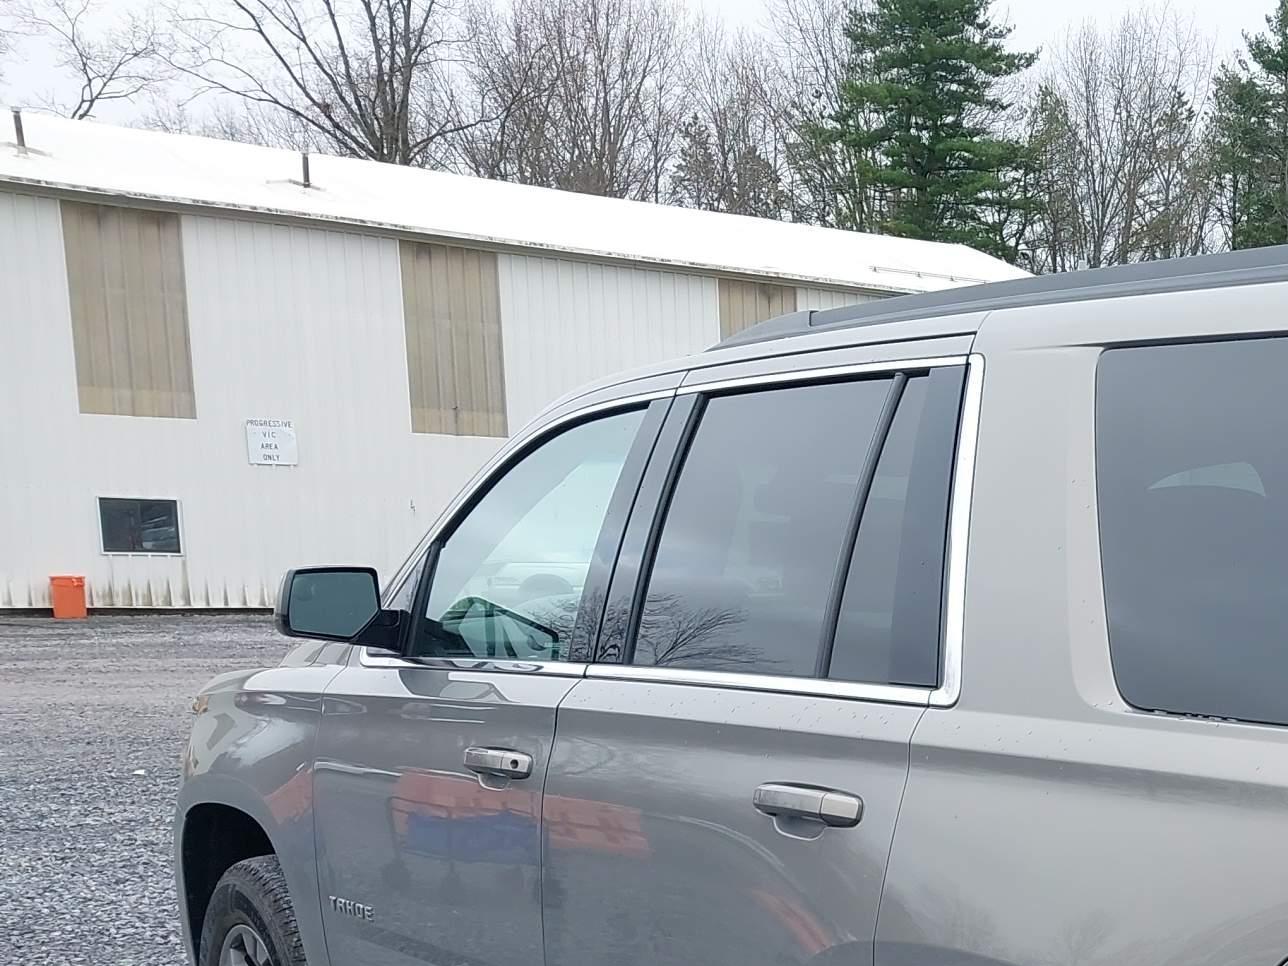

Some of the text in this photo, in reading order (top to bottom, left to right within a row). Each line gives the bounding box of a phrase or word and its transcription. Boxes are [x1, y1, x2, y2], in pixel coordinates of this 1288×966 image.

[246, 419, 293, 428] PROGRESSIVE
[260, 442, 279, 450] AREA
[262, 453, 280, 461] ONLY
[328, 895, 375, 921] TAHOE
